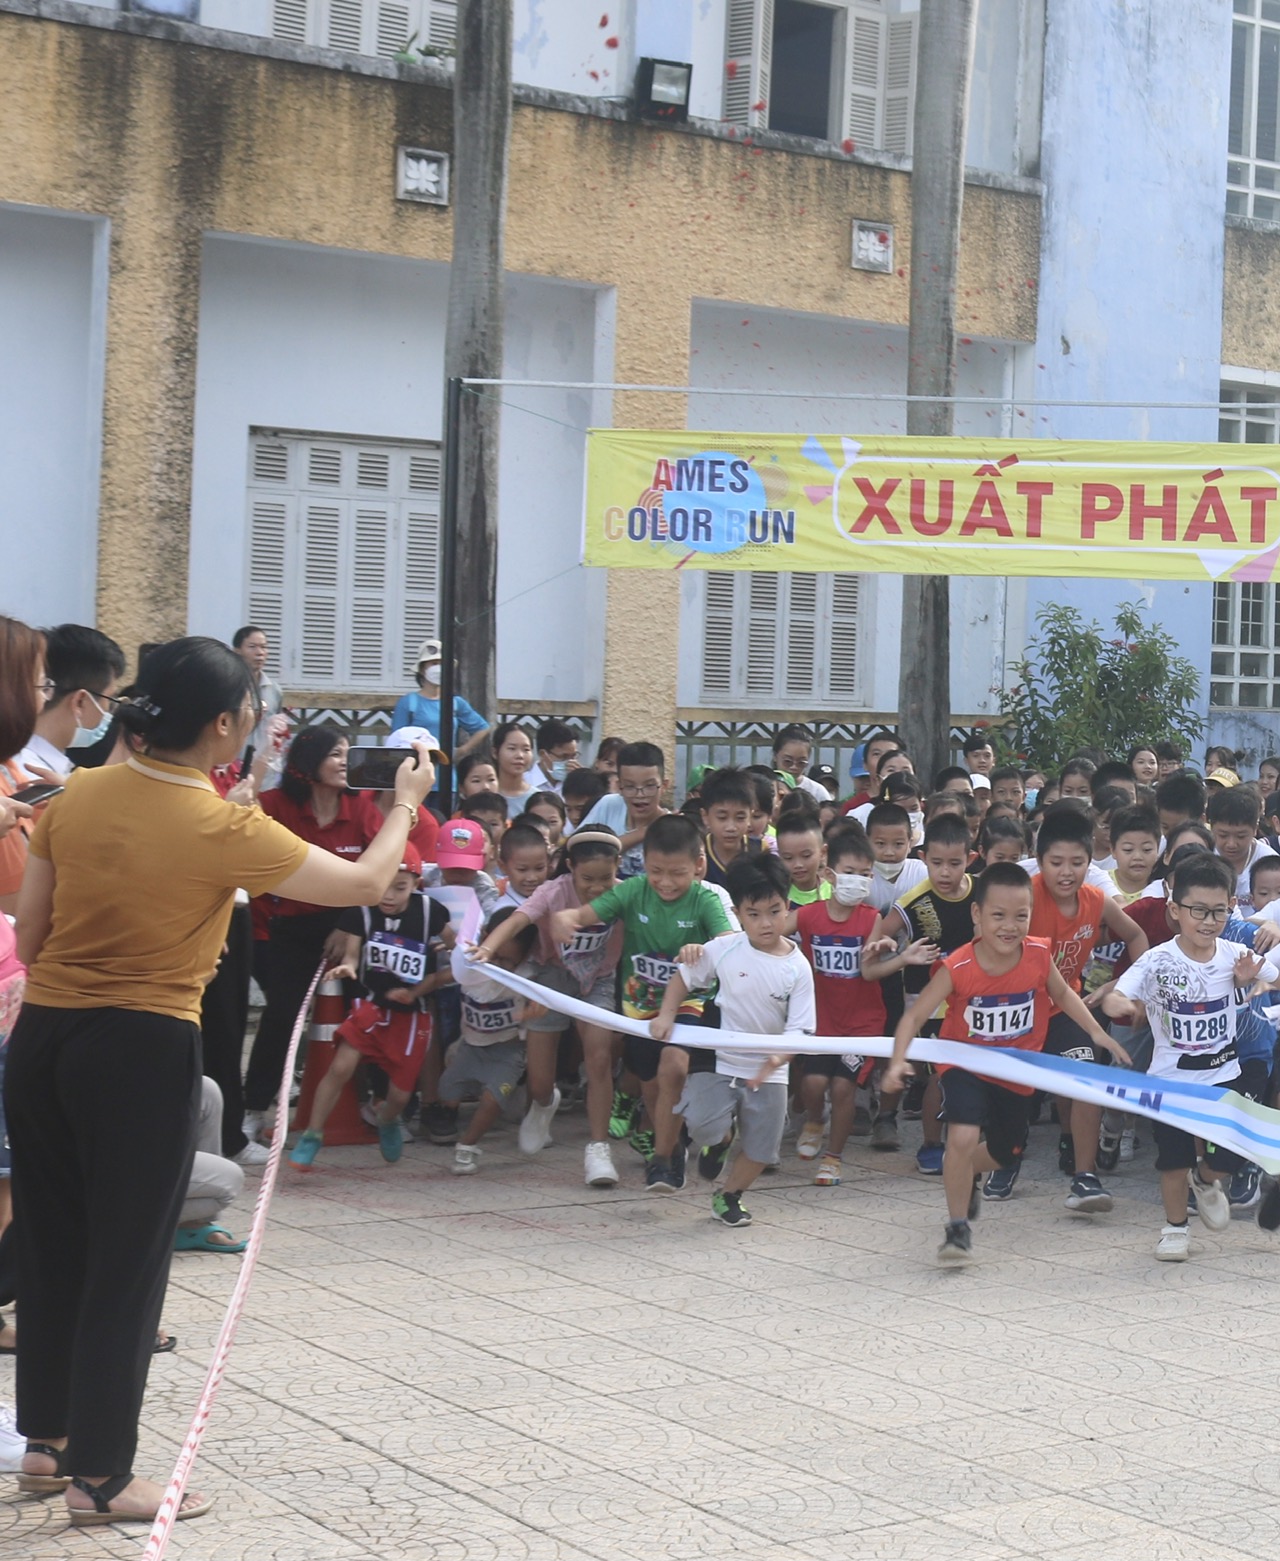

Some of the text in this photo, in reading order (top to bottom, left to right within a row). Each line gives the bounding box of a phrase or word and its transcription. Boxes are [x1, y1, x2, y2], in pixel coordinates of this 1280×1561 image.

[652, 459, 749, 493] AMES
[848, 453, 1277, 543] XUẤT PHÁT
[604, 507, 795, 544] COLOR RUN
[370, 945, 422, 976] B1163
[814, 948, 859, 971] B1201
[464, 1005, 513, 1028] B1251
[972, 1004, 1032, 1033] B1147
[1171, 1013, 1228, 1042] B1289
